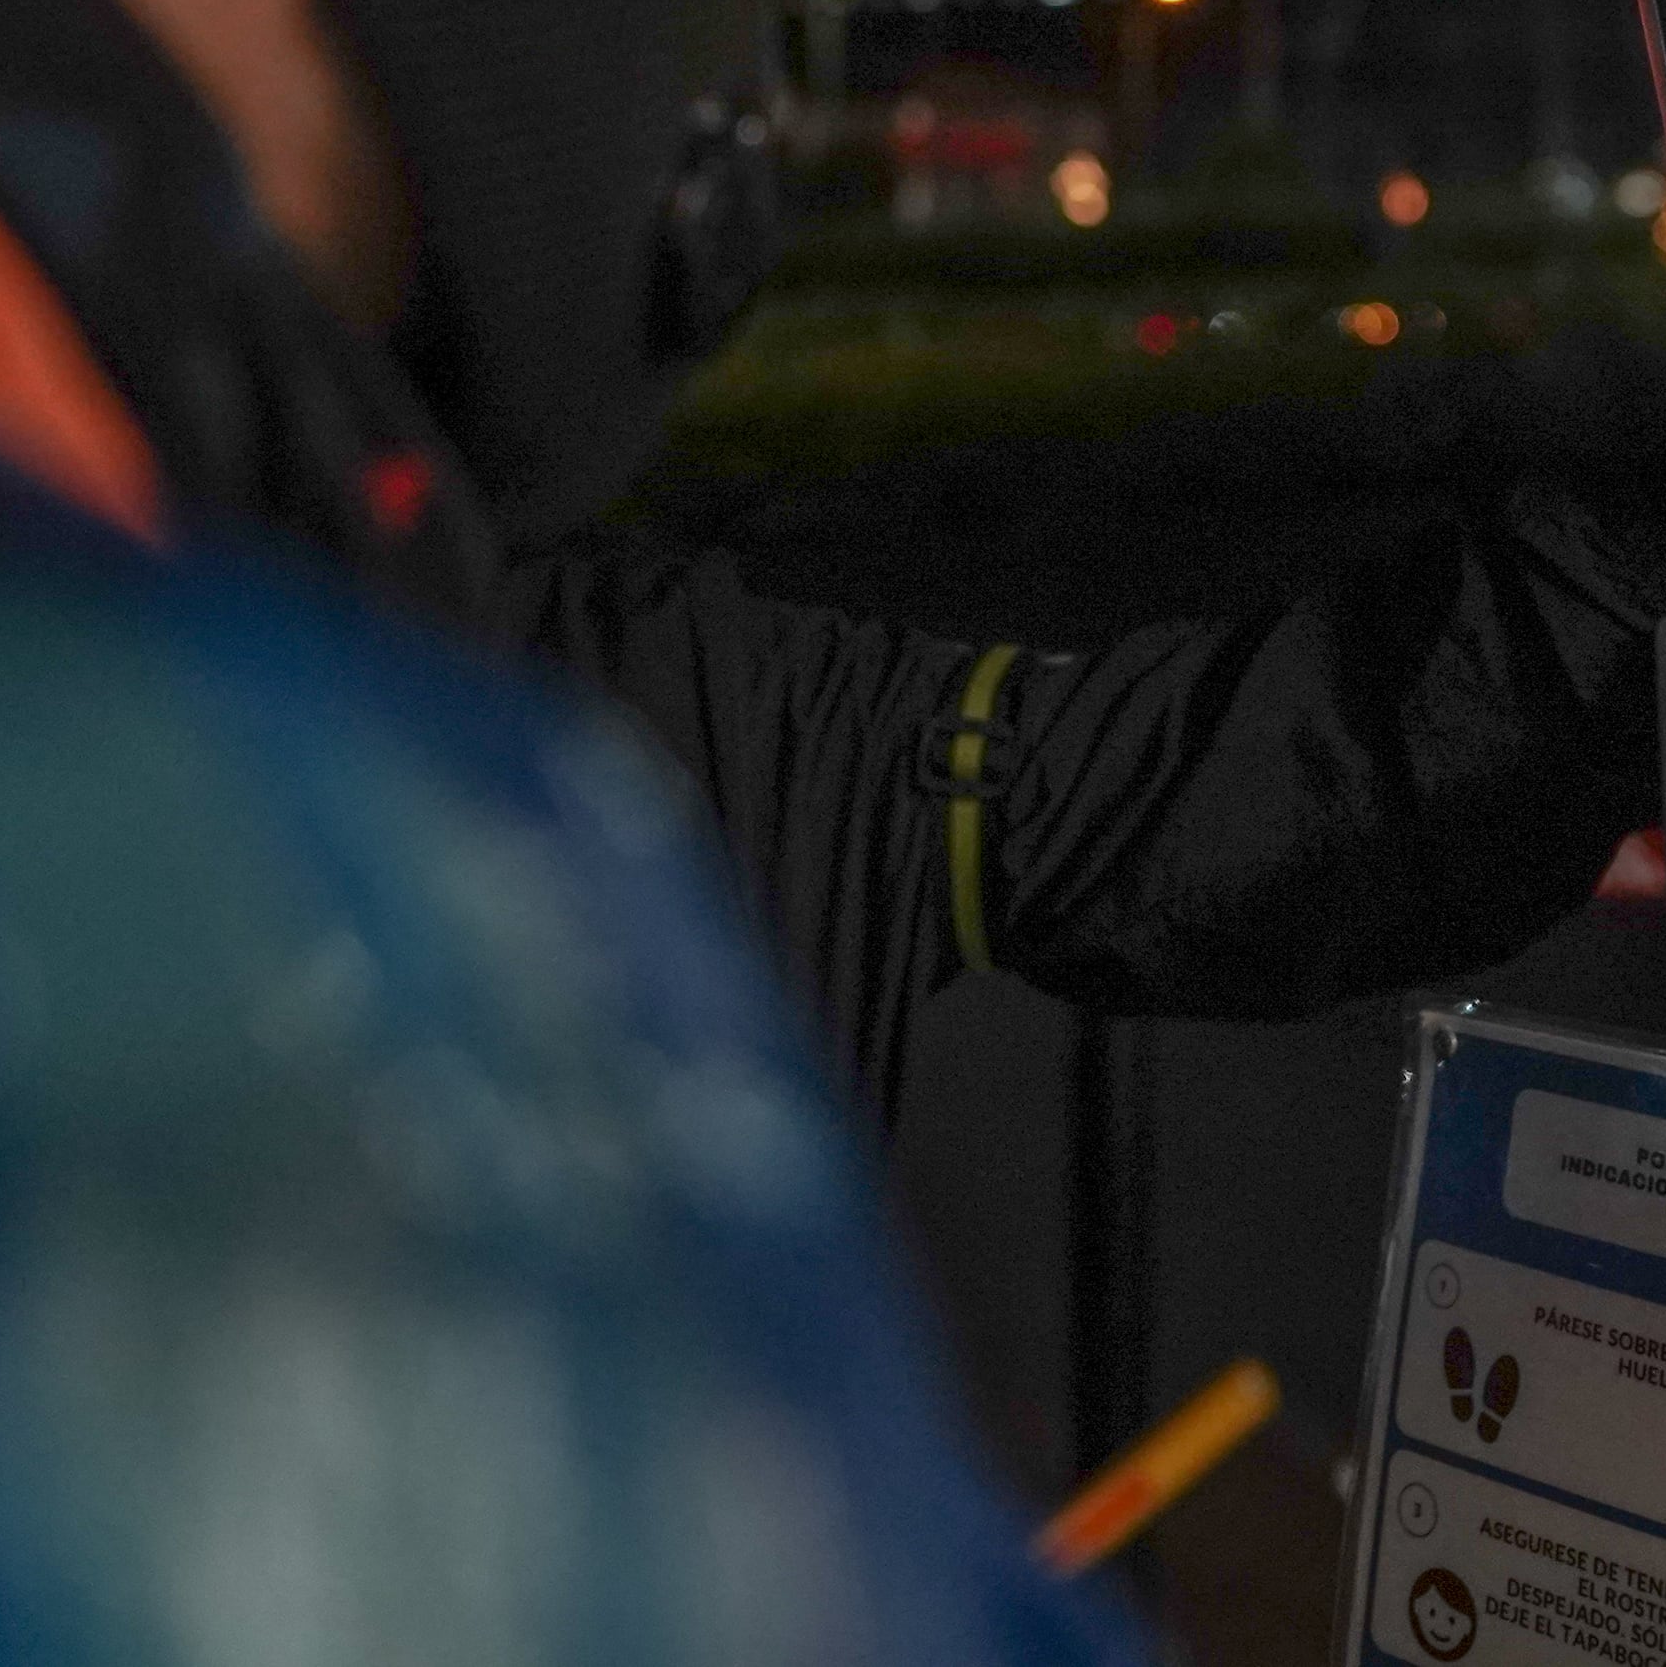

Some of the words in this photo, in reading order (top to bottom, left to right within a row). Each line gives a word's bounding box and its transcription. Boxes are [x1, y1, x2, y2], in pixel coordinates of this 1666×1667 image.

[1533, 1306, 1603, 1343] PÁRESE
[1479, 1517, 1589, 1572] ASEGURESE
[1593, 1556, 1620, 1583] DE
[1506, 1577, 1625, 1638] DESPEJADO.
[1578, 1577, 1599, 1602] EL
[1485, 1596, 1530, 1629] DEJE
[1534, 1615, 1555, 1639] EL
